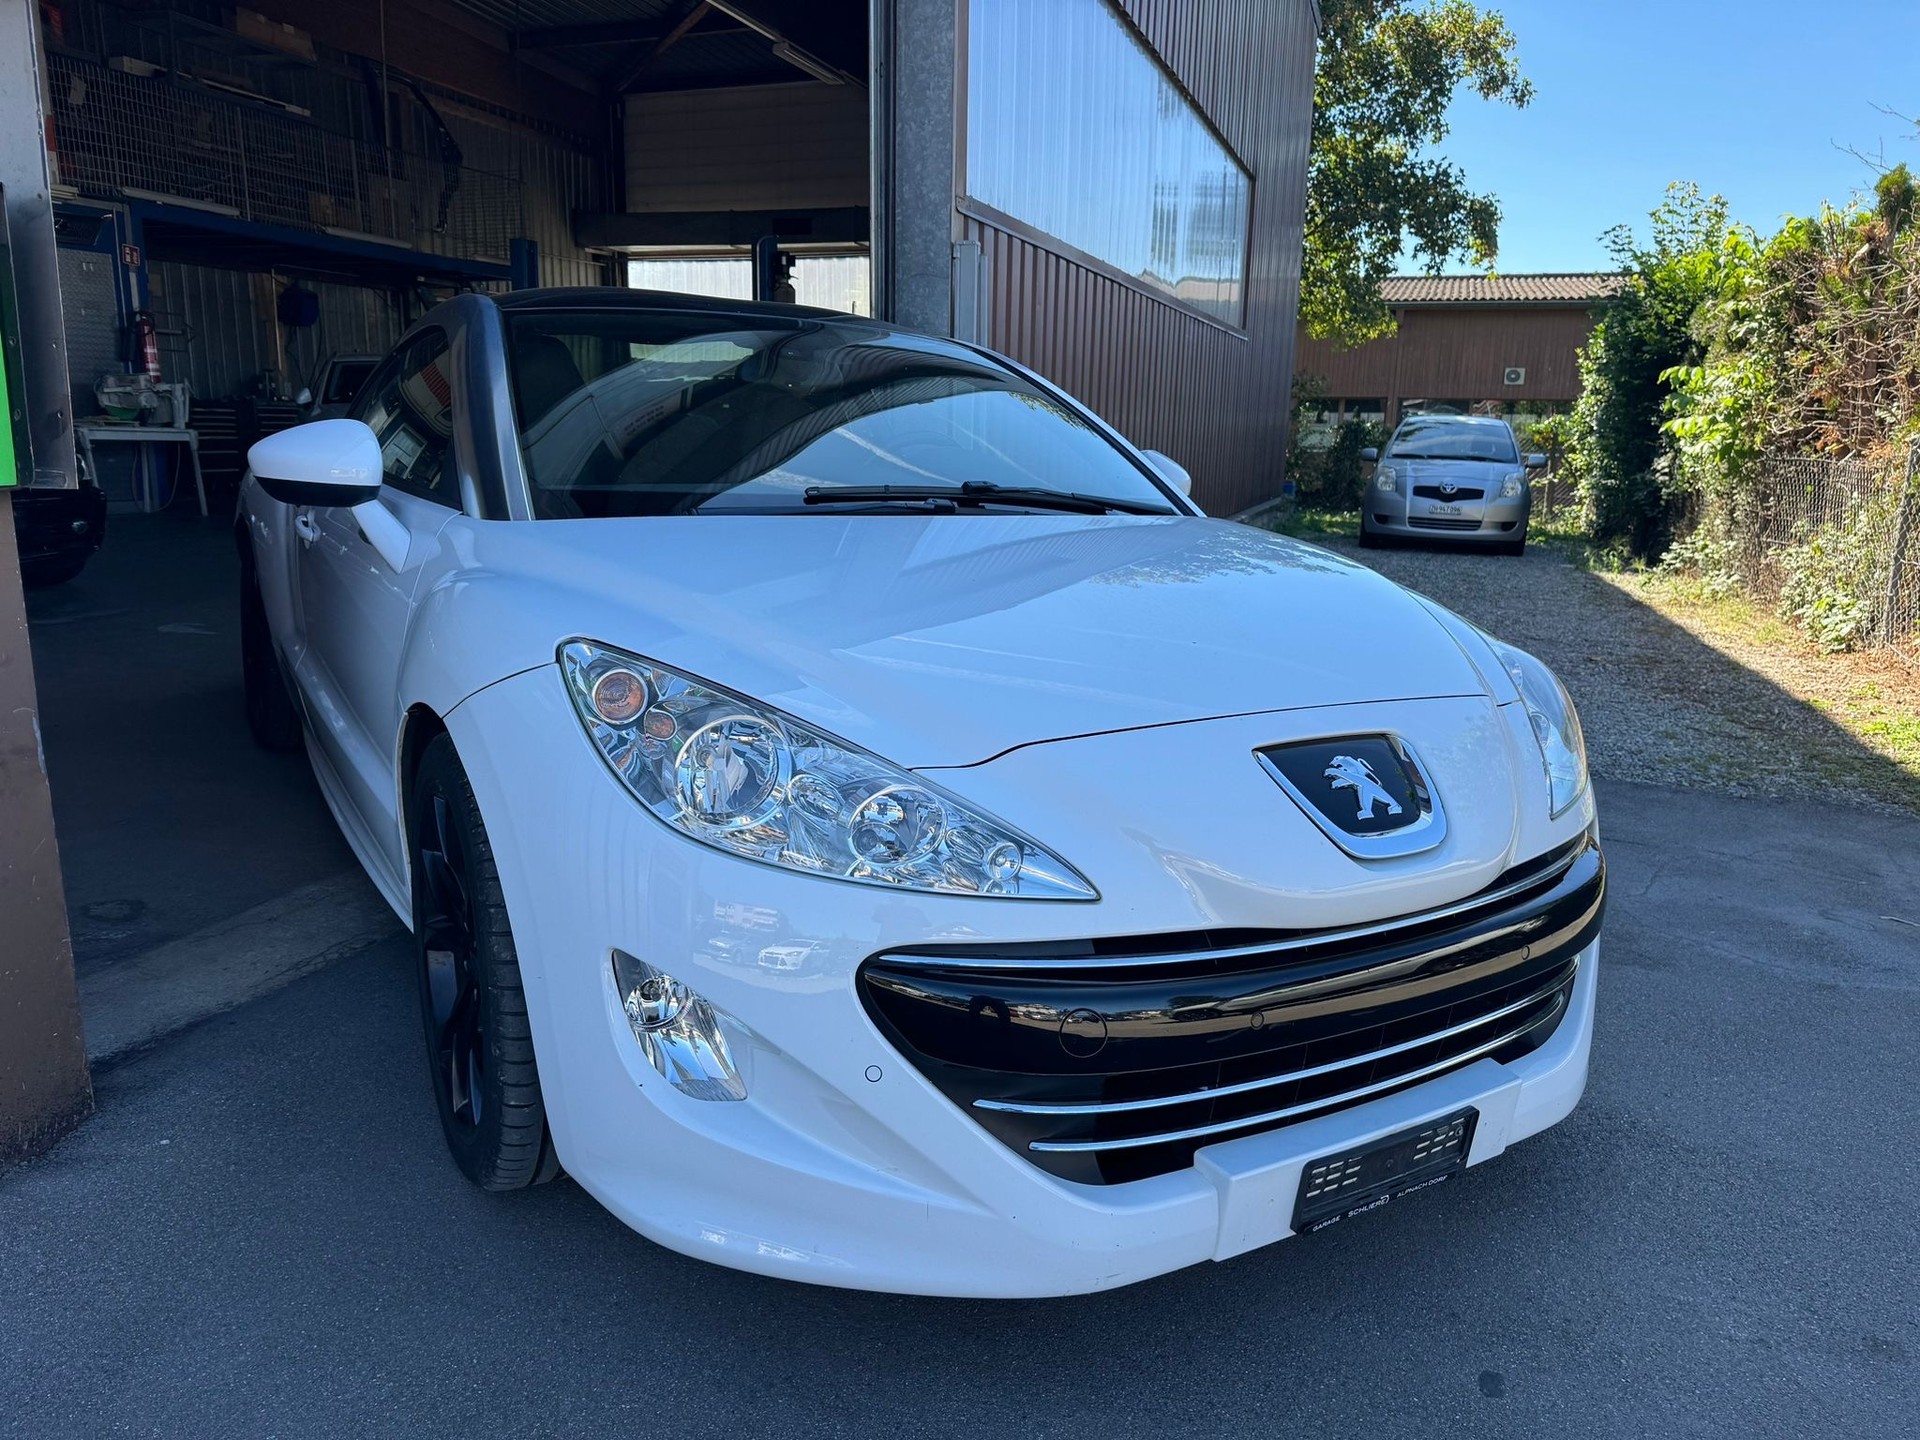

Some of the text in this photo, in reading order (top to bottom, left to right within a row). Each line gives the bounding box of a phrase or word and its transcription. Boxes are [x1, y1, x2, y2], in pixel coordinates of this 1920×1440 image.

[1312, 1215, 1341, 1231] GARAGE
[1397, 1182, 1428, 1198] ALPNACH
[1428, 1174, 1448, 1186] DORF
